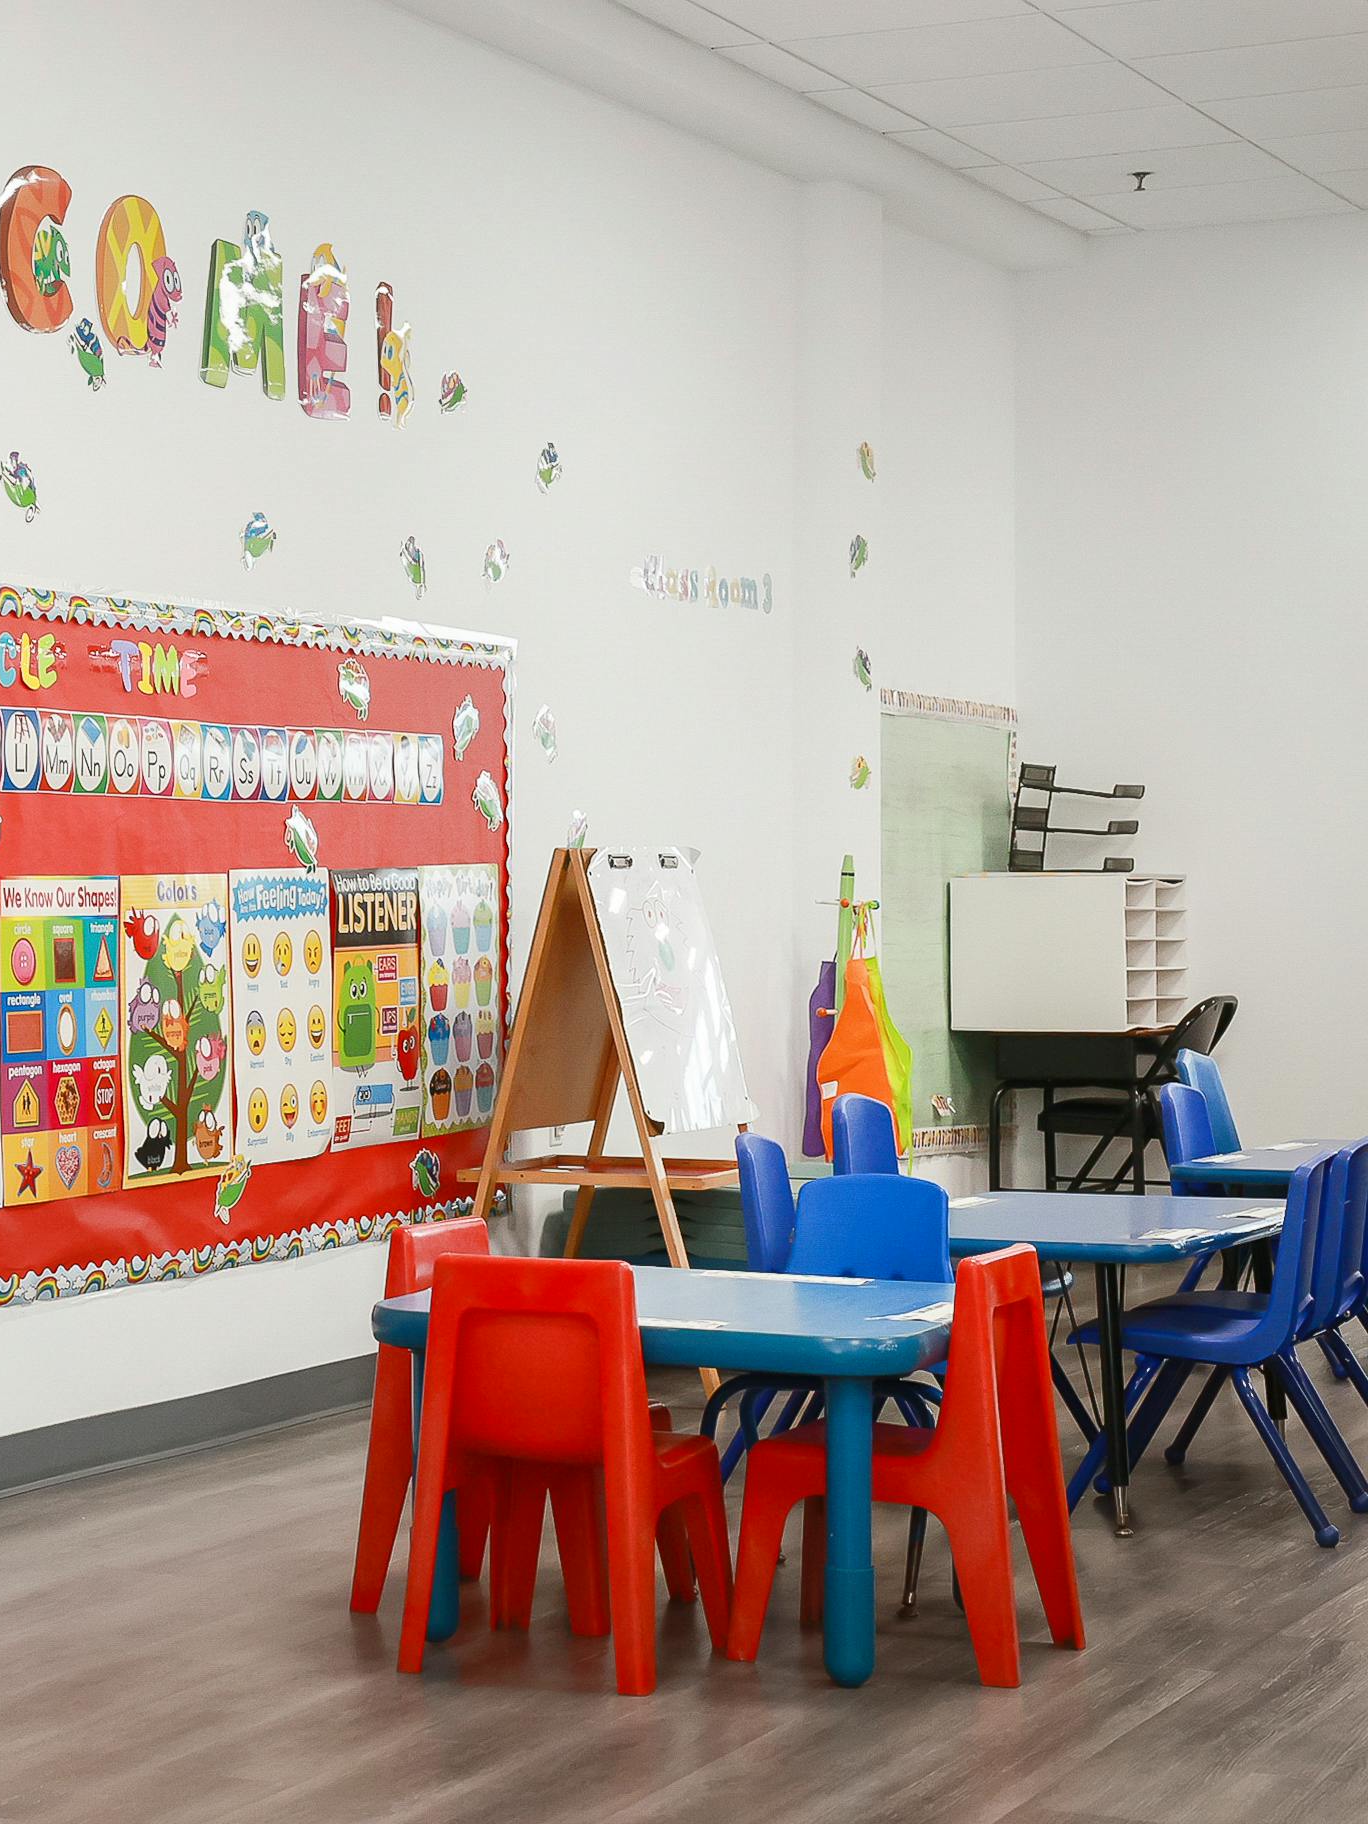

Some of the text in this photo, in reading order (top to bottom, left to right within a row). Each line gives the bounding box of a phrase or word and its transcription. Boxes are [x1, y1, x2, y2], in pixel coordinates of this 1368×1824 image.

[110, 638, 197, 699] TIME
[14, 743, 28, 772] Ll
[45, 744, 69, 775] Mm
[81, 748, 101, 777] Nn
[114, 750, 133, 777] Oo
[148, 751, 165, 791] Pp
[180, 754, 197, 792] Qq
[209, 757, 224, 783] Rr
[239, 758, 254, 784] Ss
[295, 759, 311, 785] Uu
[157, 880, 197, 902] Colors
[335, 875, 357, 893] How
[358, 875, 369, 892] to
[369, 875, 382, 891] Be
[383, 880, 391, 891] a
[3, 886, 117, 912] We Know Our Shapes!
[256, 884, 297, 912] Feeling
[297, 886, 326, 910] Today?
[338, 891, 417, 934] LISTENER
[7, 992, 41, 1008] rectangle
[8, 1065, 43, 1080] pentagon
[52, 1062, 81, 1075] hexagon
[93, 1059, 116, 1072] octagon
[97, 1088, 114, 1105] STOP
[336, 1118, 350, 1133] FEET
